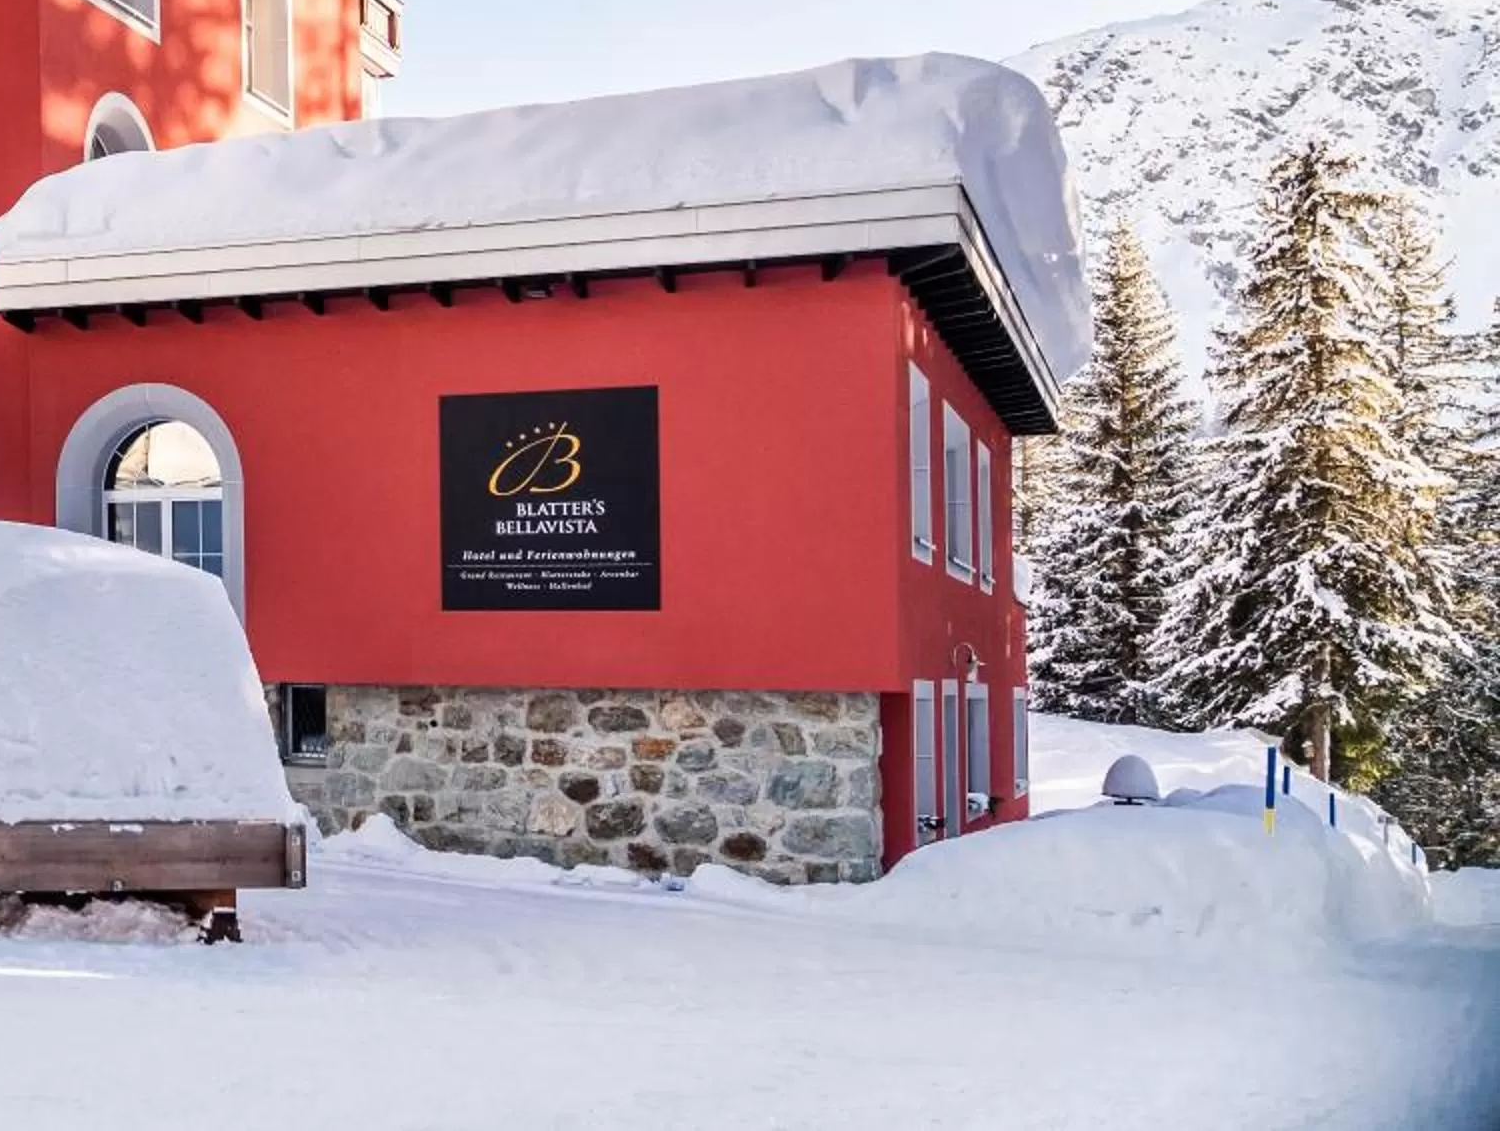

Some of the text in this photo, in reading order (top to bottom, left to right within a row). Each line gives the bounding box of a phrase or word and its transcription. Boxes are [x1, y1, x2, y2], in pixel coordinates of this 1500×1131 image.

[516, 499, 605, 517] BLATTER'S
[496, 519, 598, 535] BELLAVISTA
[462, 548, 637, 562] Hotel und Ferienwohnungen
